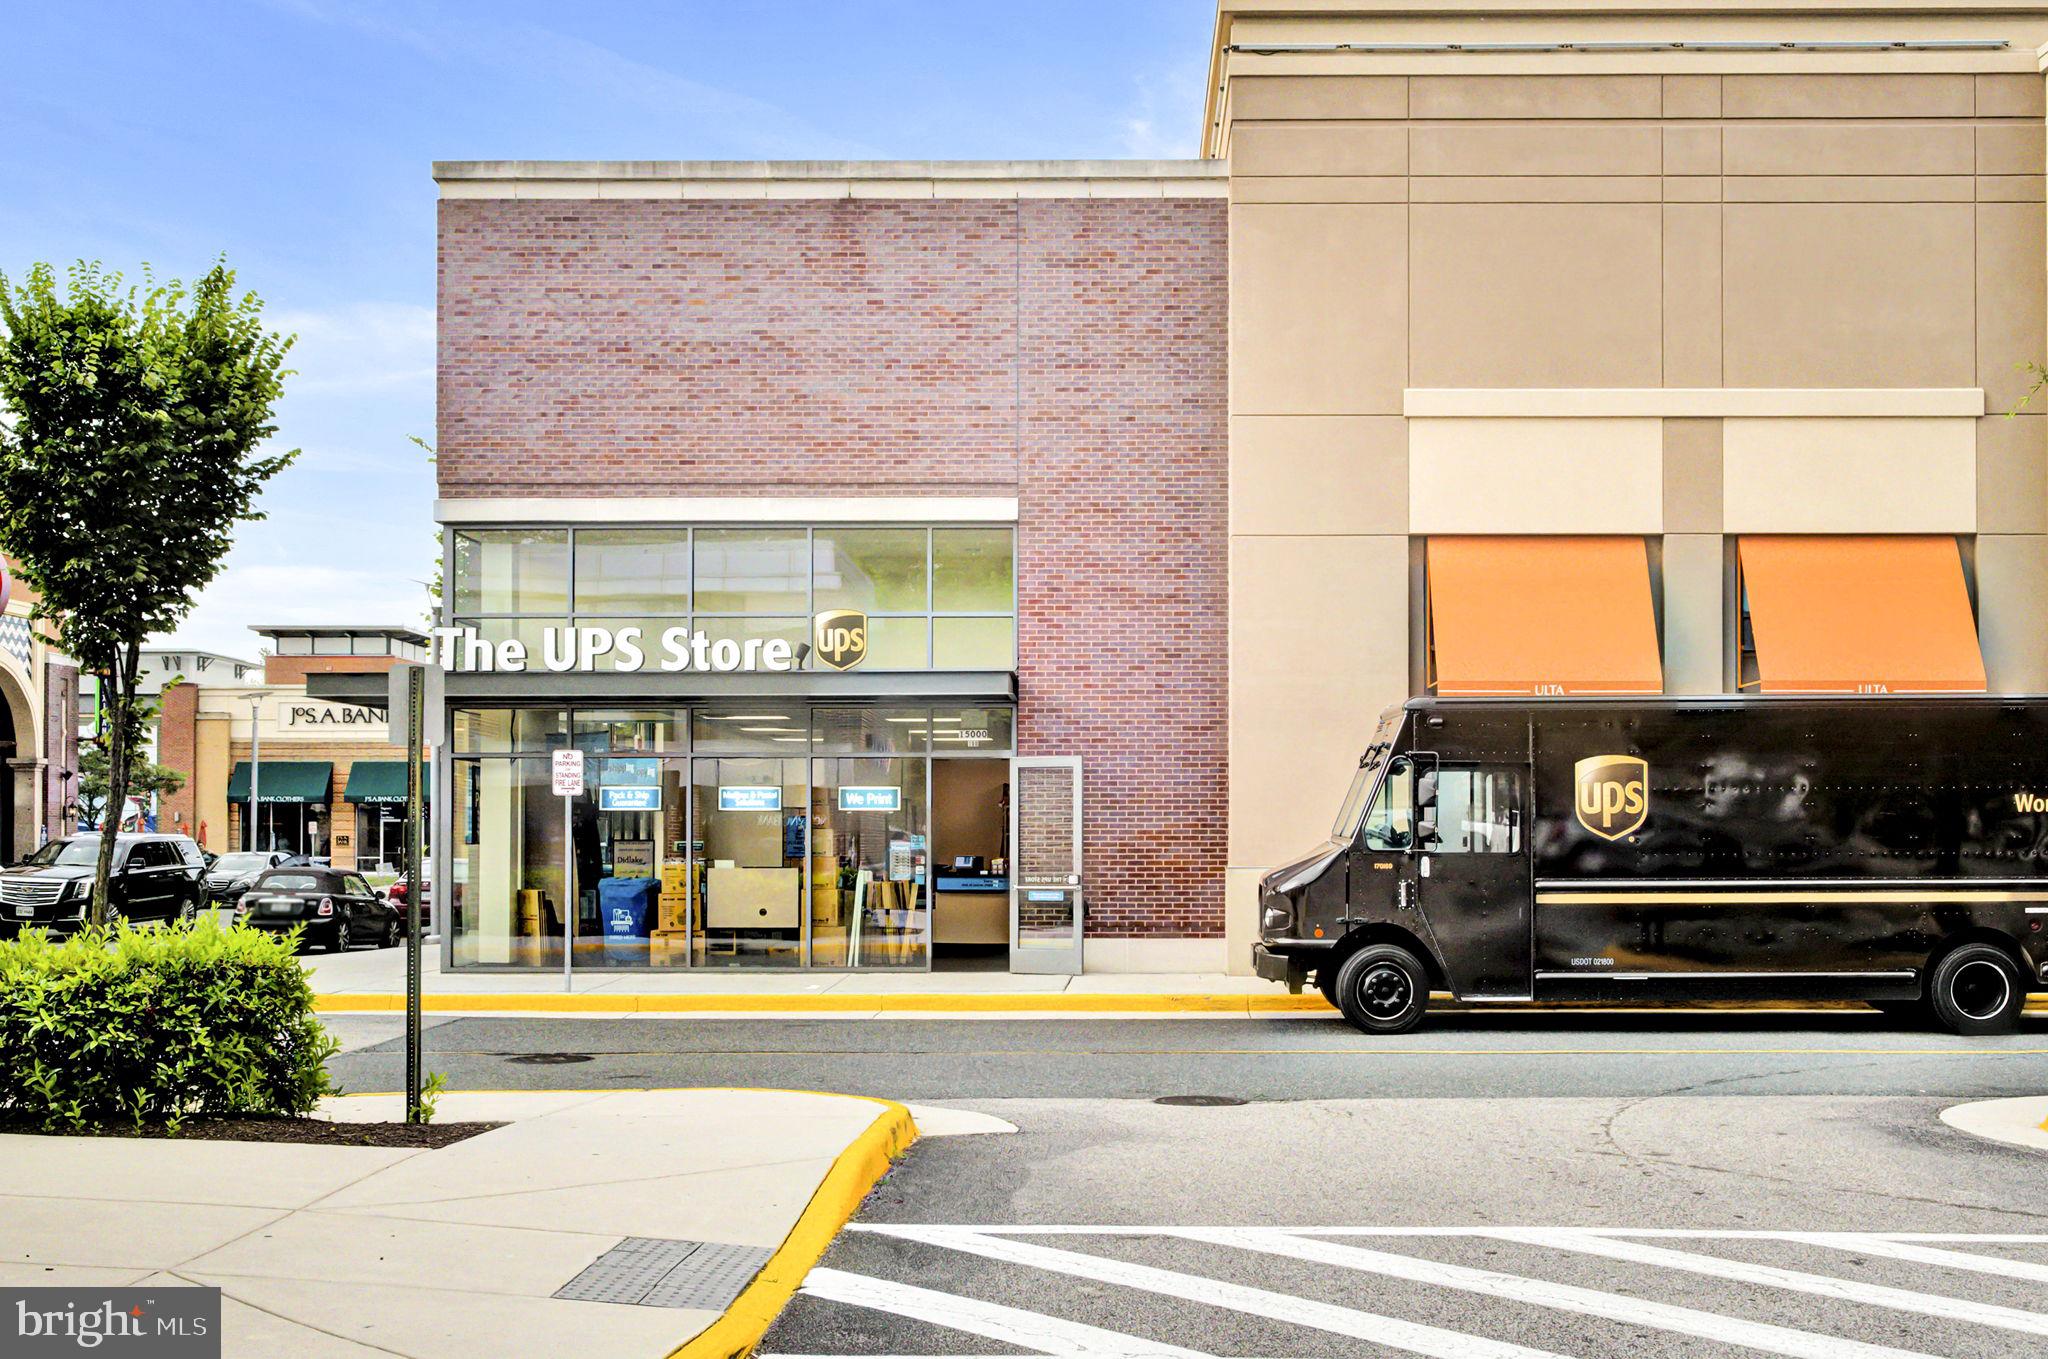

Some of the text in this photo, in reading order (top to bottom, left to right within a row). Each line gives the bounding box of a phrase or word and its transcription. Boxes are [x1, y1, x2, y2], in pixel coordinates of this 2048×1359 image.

[434, 627, 792, 672] The UPS Store
[818, 627, 864, 661] ups
[1535, 685, 1564, 696] ULTA
[342, 707, 389, 724] BAN
[960, 730, 987, 738] 15000
[609, 791, 650, 802] Pack & Ship
[846, 792, 893, 805] We Print
[1581, 781, 1643, 827] ups
